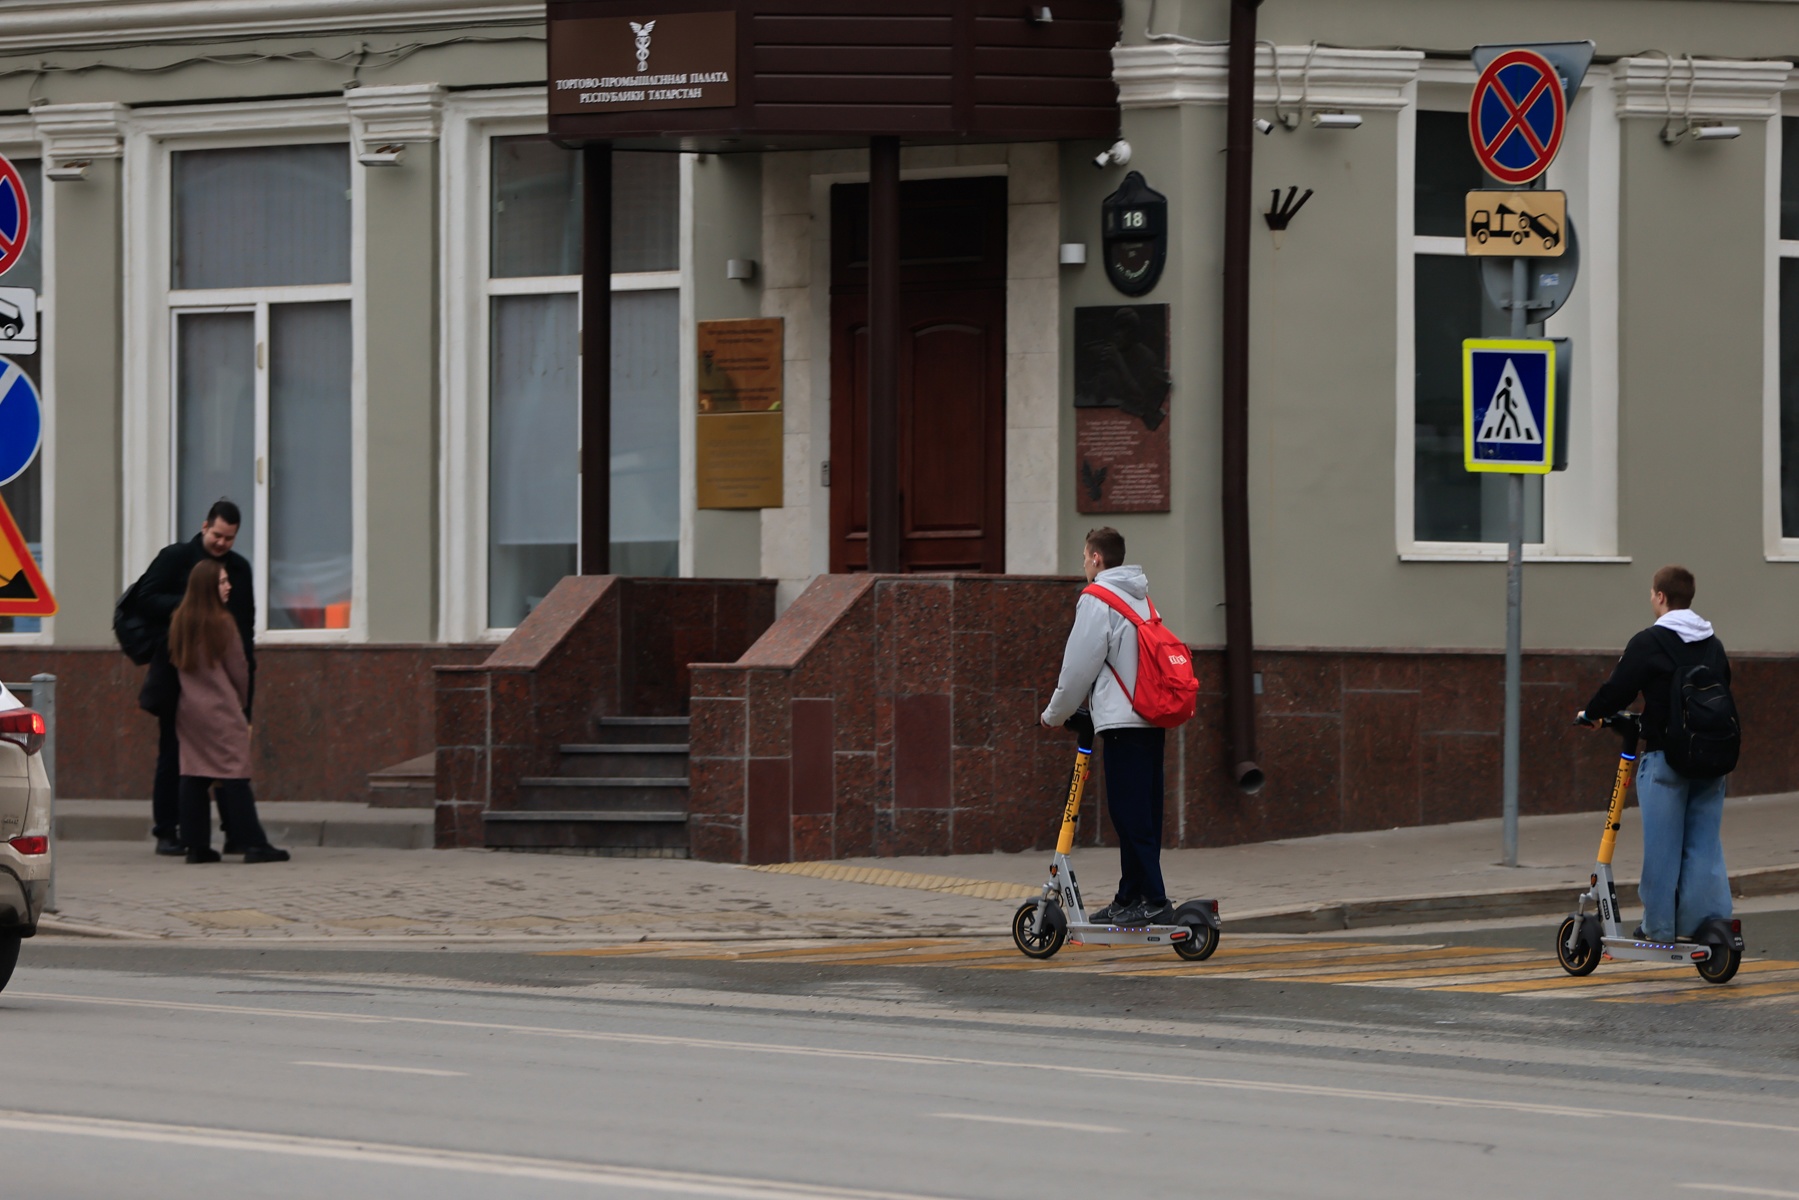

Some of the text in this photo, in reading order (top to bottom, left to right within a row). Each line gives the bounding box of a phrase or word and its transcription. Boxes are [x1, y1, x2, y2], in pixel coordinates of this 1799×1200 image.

[690, 72, 729, 83] ПАЛАТА
[580, 88, 702, 103] РЕСПУБЛИКИ ТАТАРСТАН
[1124, 211, 1143, 227] 18
[1064, 763, 1082, 822] WHOOSH
[1605, 769, 1623, 829] WHOOSH
